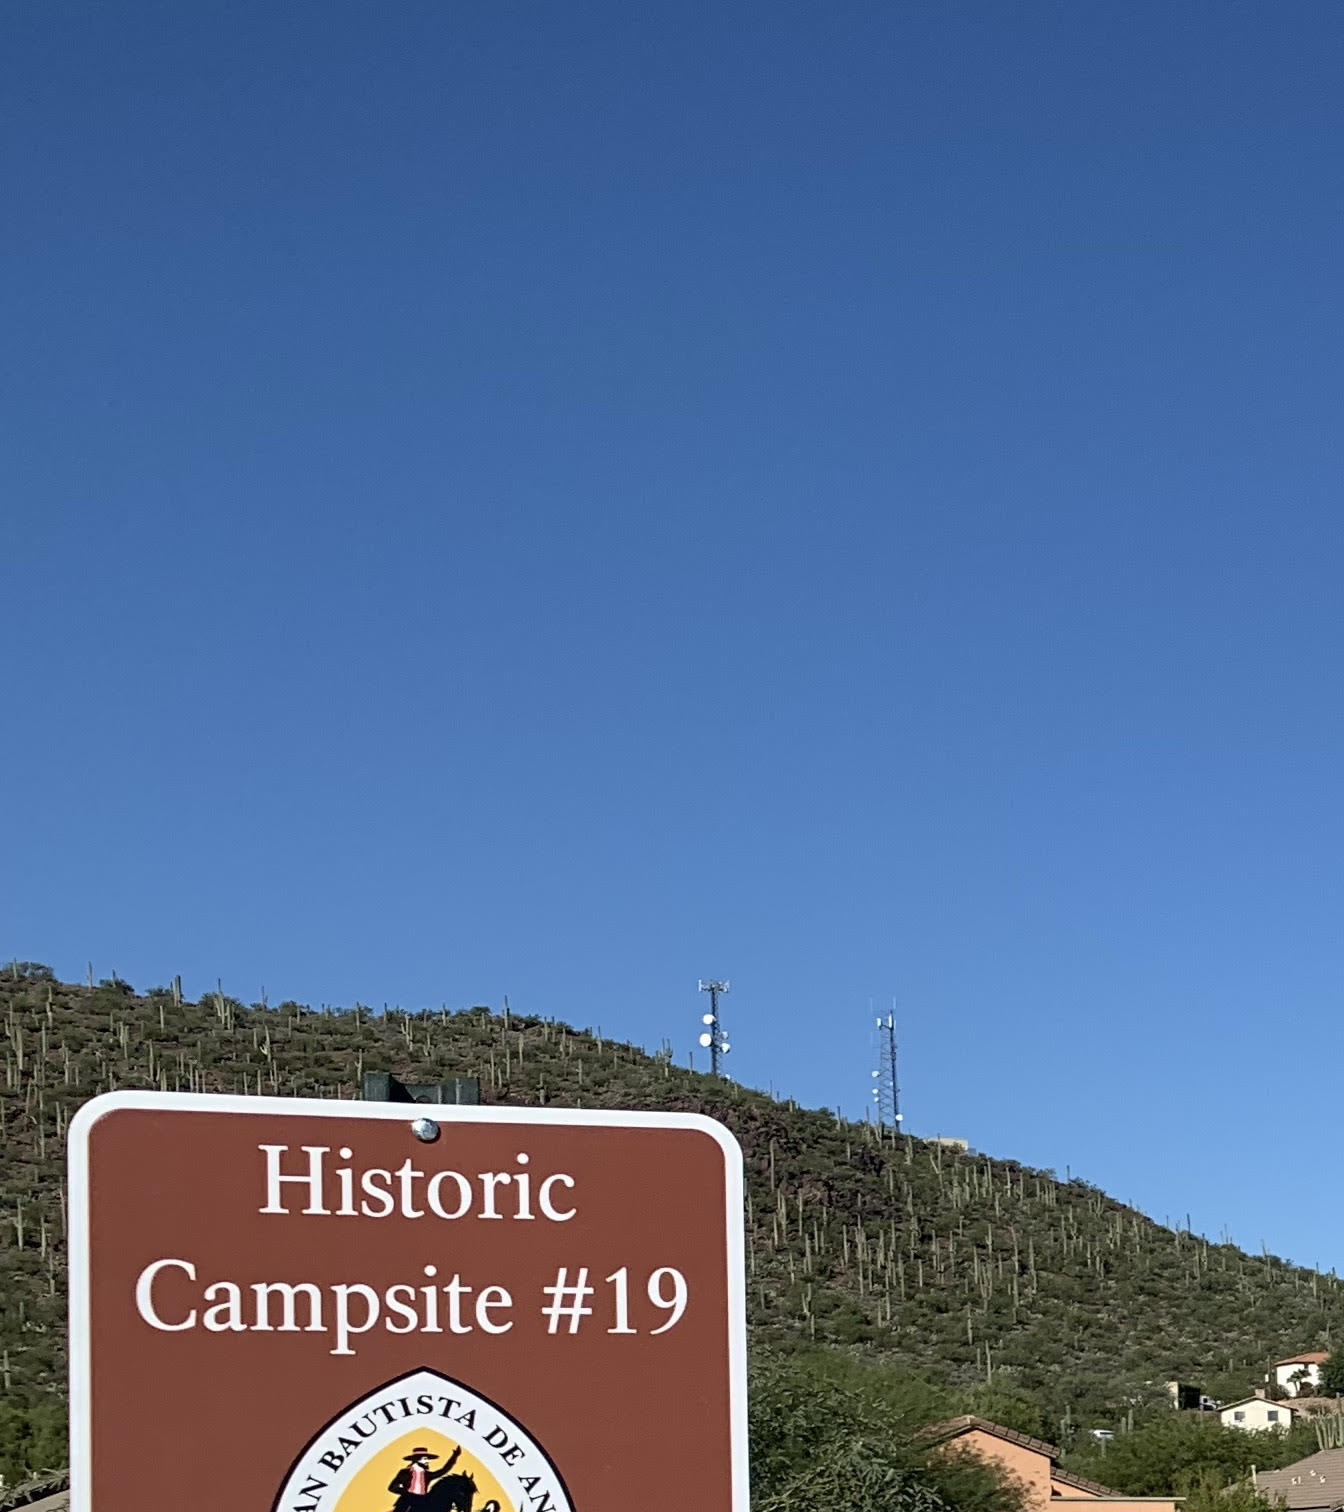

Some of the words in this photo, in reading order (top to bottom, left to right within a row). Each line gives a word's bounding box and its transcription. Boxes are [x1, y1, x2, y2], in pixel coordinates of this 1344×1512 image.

[259, 1144, 578, 1221] Historic
[135, 1258, 515, 1355] Campsite
[542, 1266, 688, 1335] #19
[318, 1394, 477, 1473] BAUTISTA
[482, 1425, 526, 1468] DE
